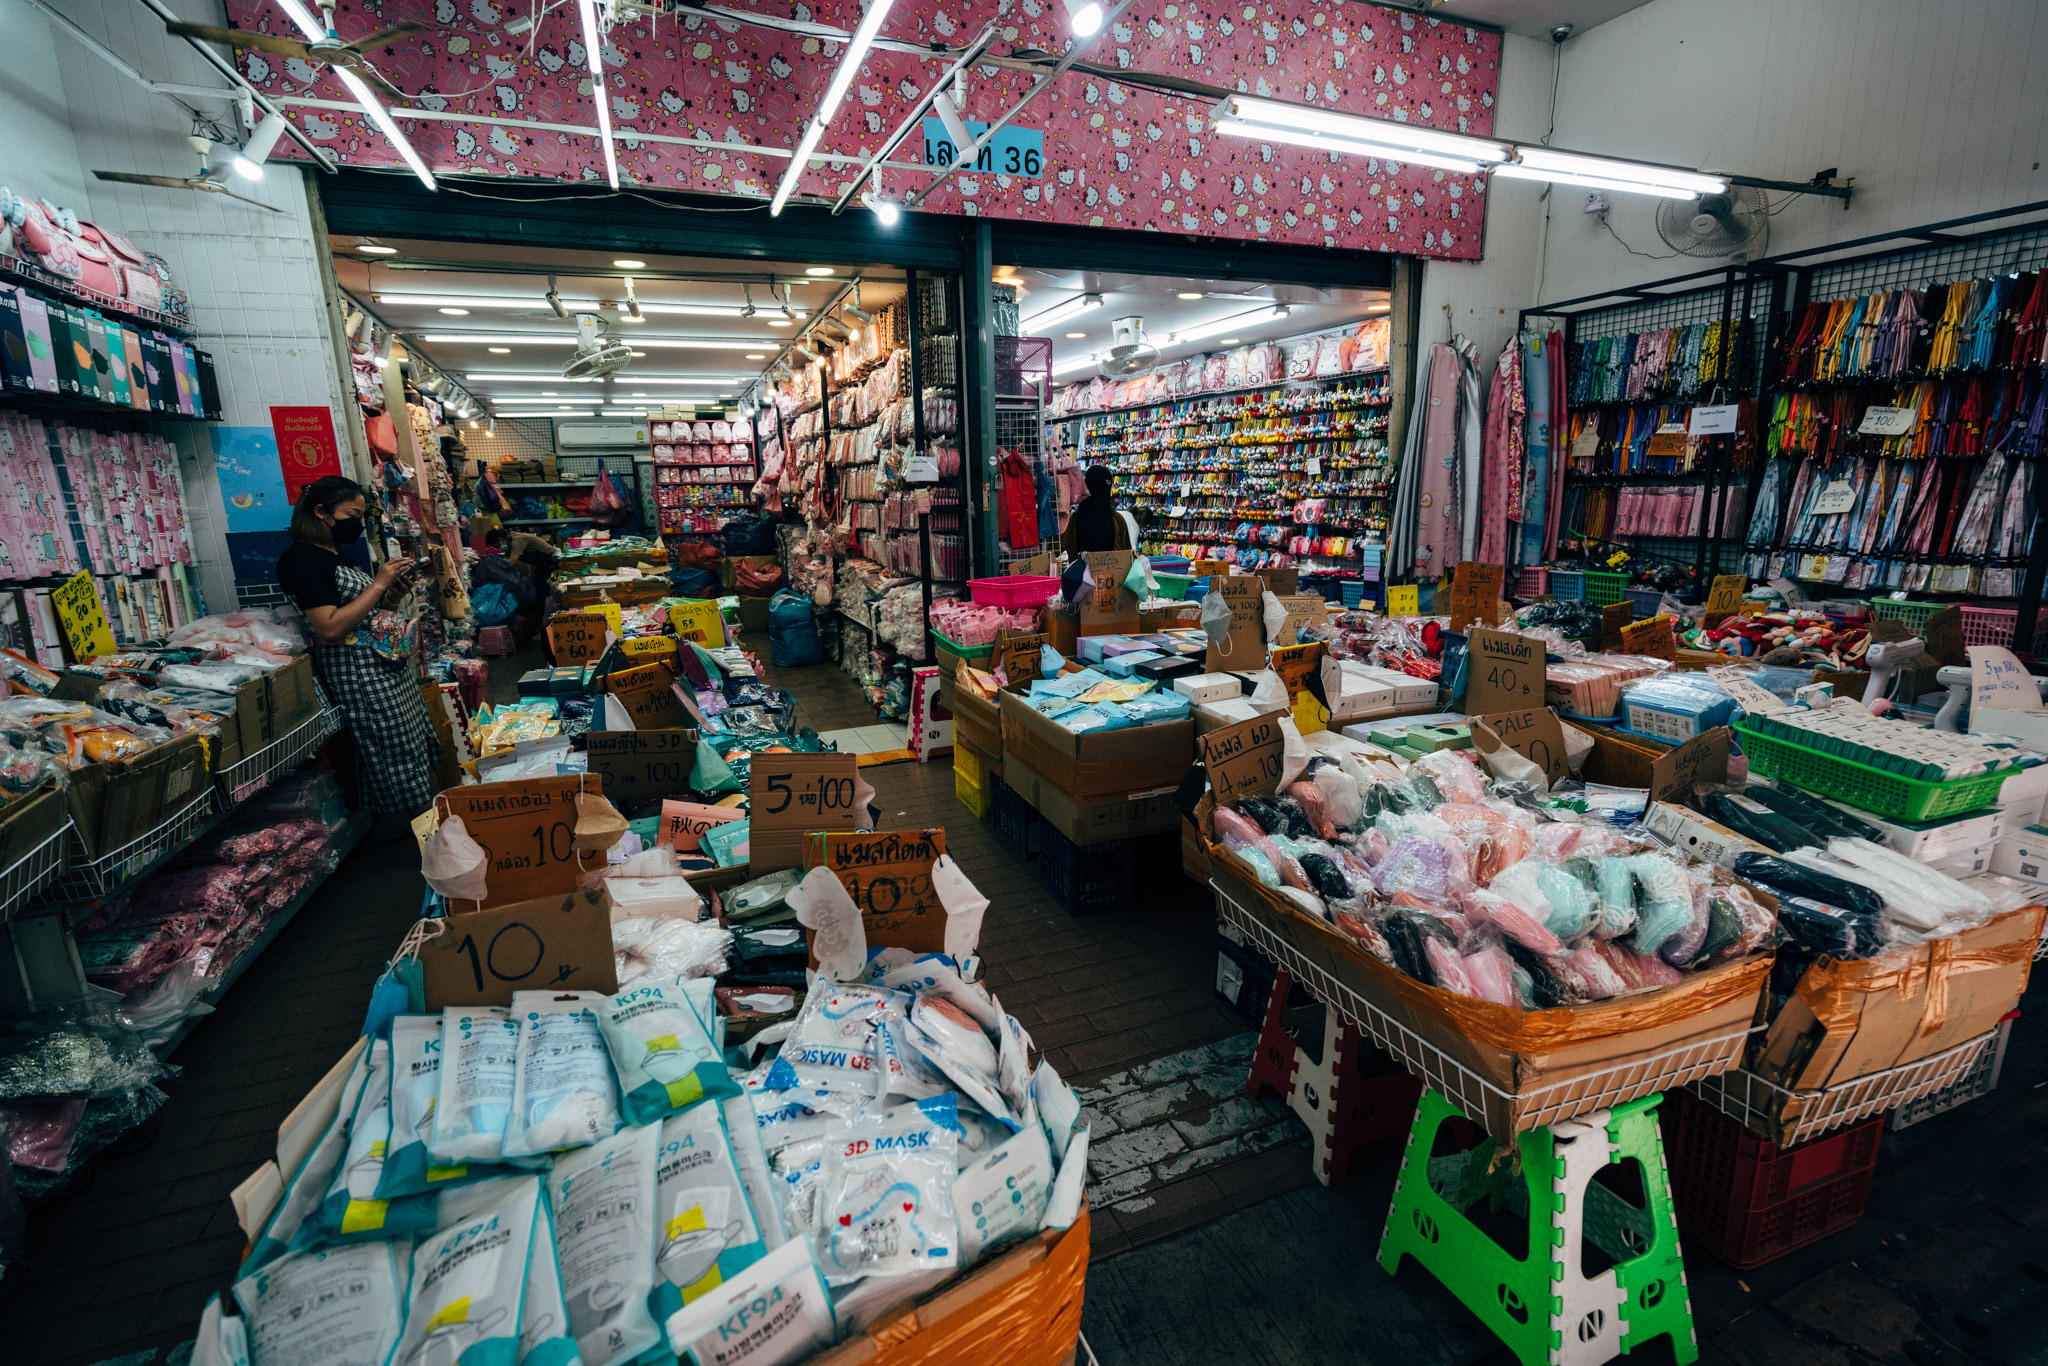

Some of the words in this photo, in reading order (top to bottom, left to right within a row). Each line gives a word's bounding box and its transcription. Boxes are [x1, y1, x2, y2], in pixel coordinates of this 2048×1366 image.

[925, 122, 993, 172] เลที่
[1005, 146, 1040, 175] 36
[1240, 601, 1256, 610] 100
[1469, 586, 1480, 608] 5
[1714, 590, 1733, 610] 10
[75, 604, 89, 621] 80
[81, 622, 94, 642] 100
[682, 618, 695, 630] 55
[566, 630, 585, 643] 50
[1648, 634, 1667, 651] 150
[569, 645, 587, 659] 60
[1010, 662, 1021, 679] 3
[1985, 660, 1992, 675] 5
[1487, 666, 1517, 692] 40
[650, 691, 677, 714] 100
[1493, 712, 1536, 738] SALE
[645, 762, 681, 783] 100
[1220, 771, 1233, 794] 4
[766, 773, 793, 815] 5
[817, 774, 856, 816] 100
[1713, 845, 1726, 861] ASK
[457, 921, 546, 993] 10
[615, 987, 664, 1008] KF94
[798, 1049, 847, 1067] MASK
[851, 1055, 874, 1071] 3D
[658, 1134, 695, 1164] F94
[844, 1140, 869, 1157] 3D
[875, 1131, 930, 1151] MASK
[718, 1285, 784, 1343] KF94
[1581, 1309, 1602, 1343] N
